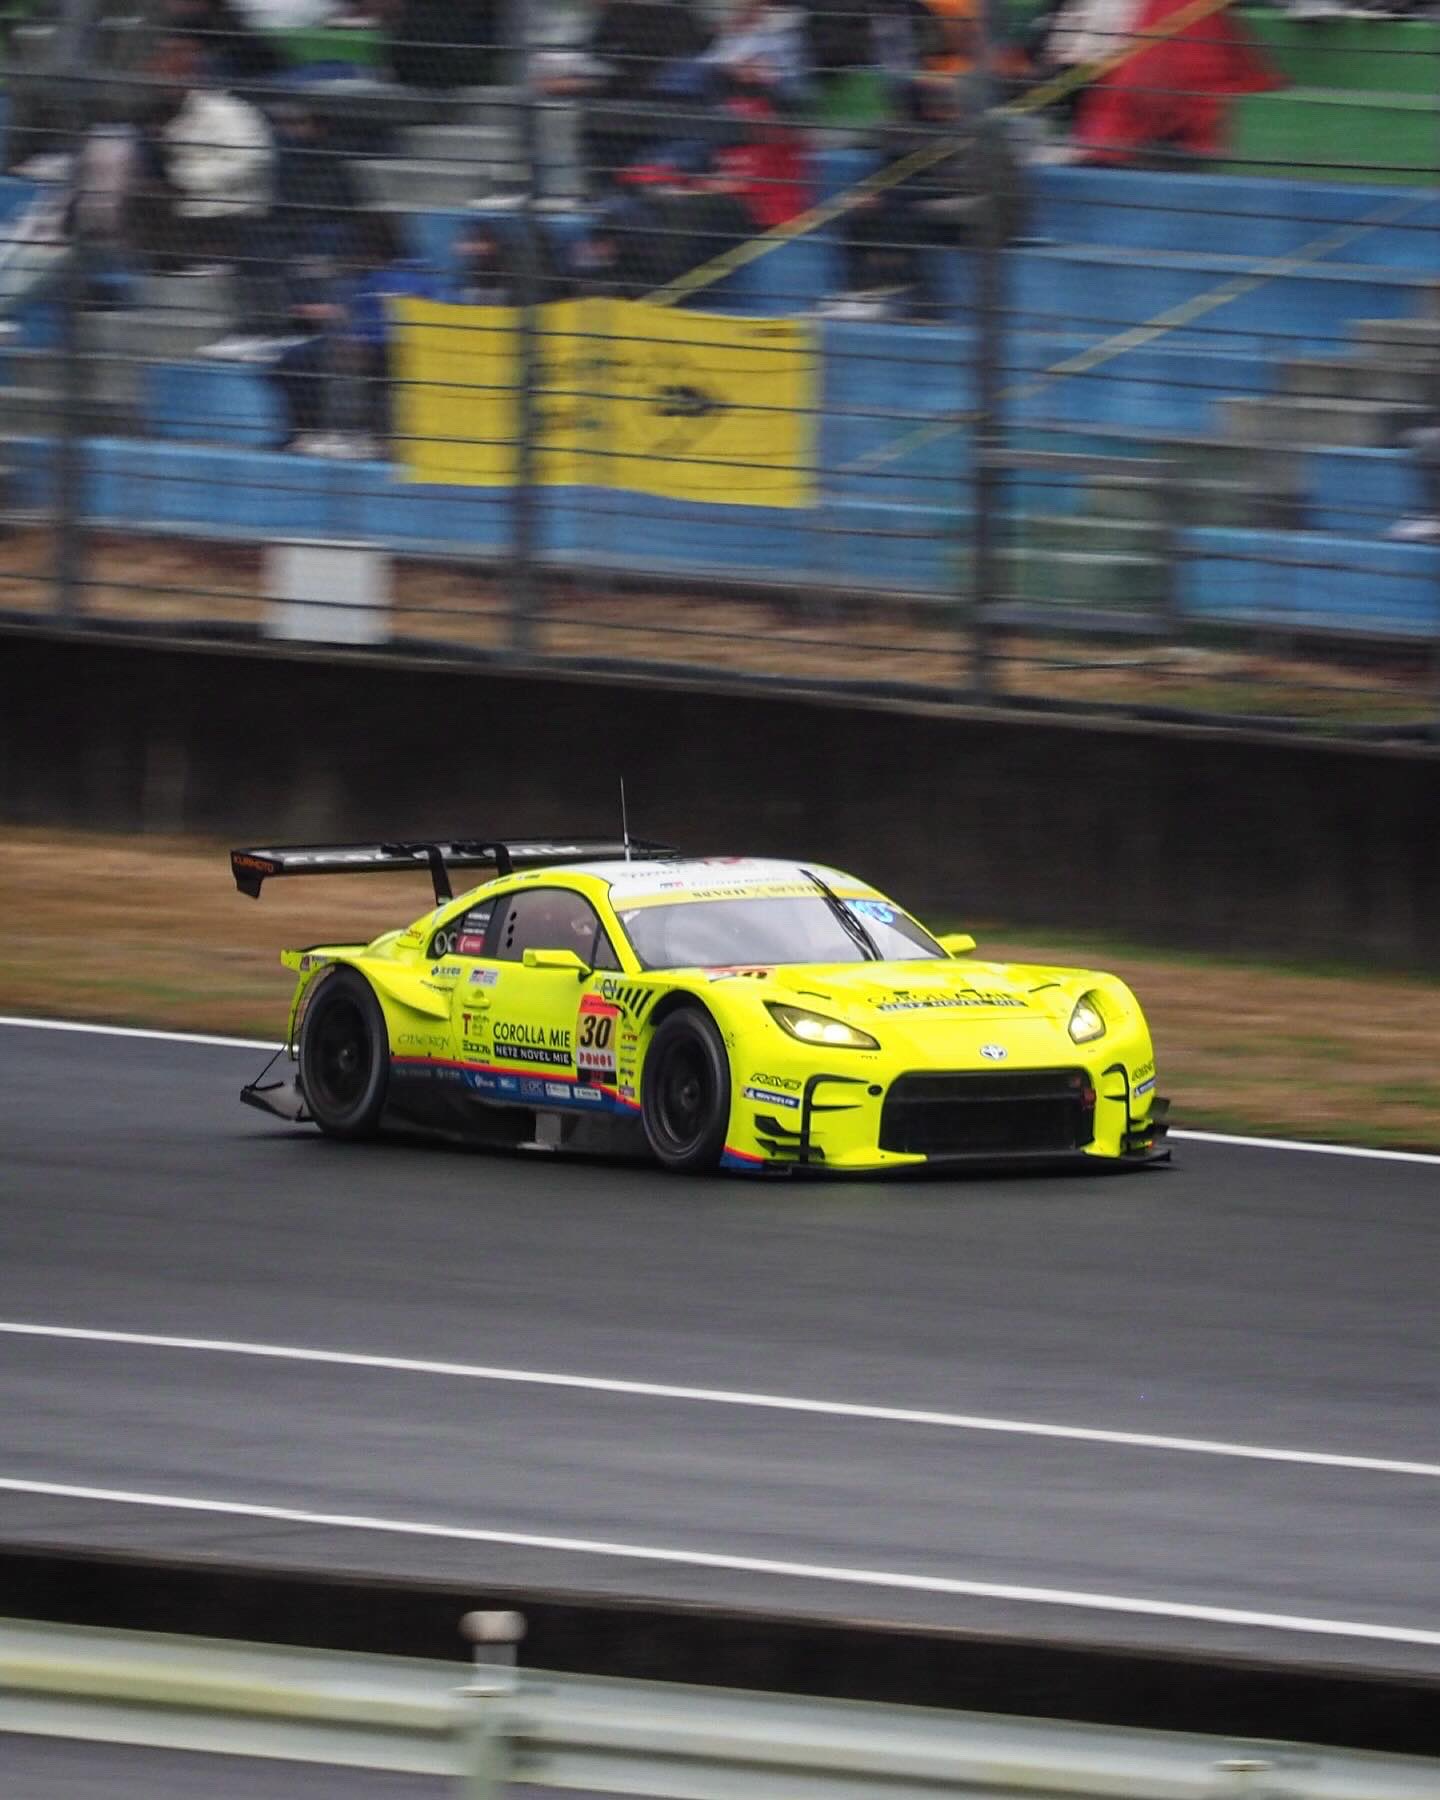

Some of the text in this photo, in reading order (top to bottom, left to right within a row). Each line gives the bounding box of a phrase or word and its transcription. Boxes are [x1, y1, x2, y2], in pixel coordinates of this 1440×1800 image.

[493, 1022, 546, 1046] COROLLA
[549, 1029, 571, 1048] MIE
[580, 1014, 612, 1049] 30
[520, 1048, 551, 1062] NOVEL
[552, 1053, 570, 1063] MIE
